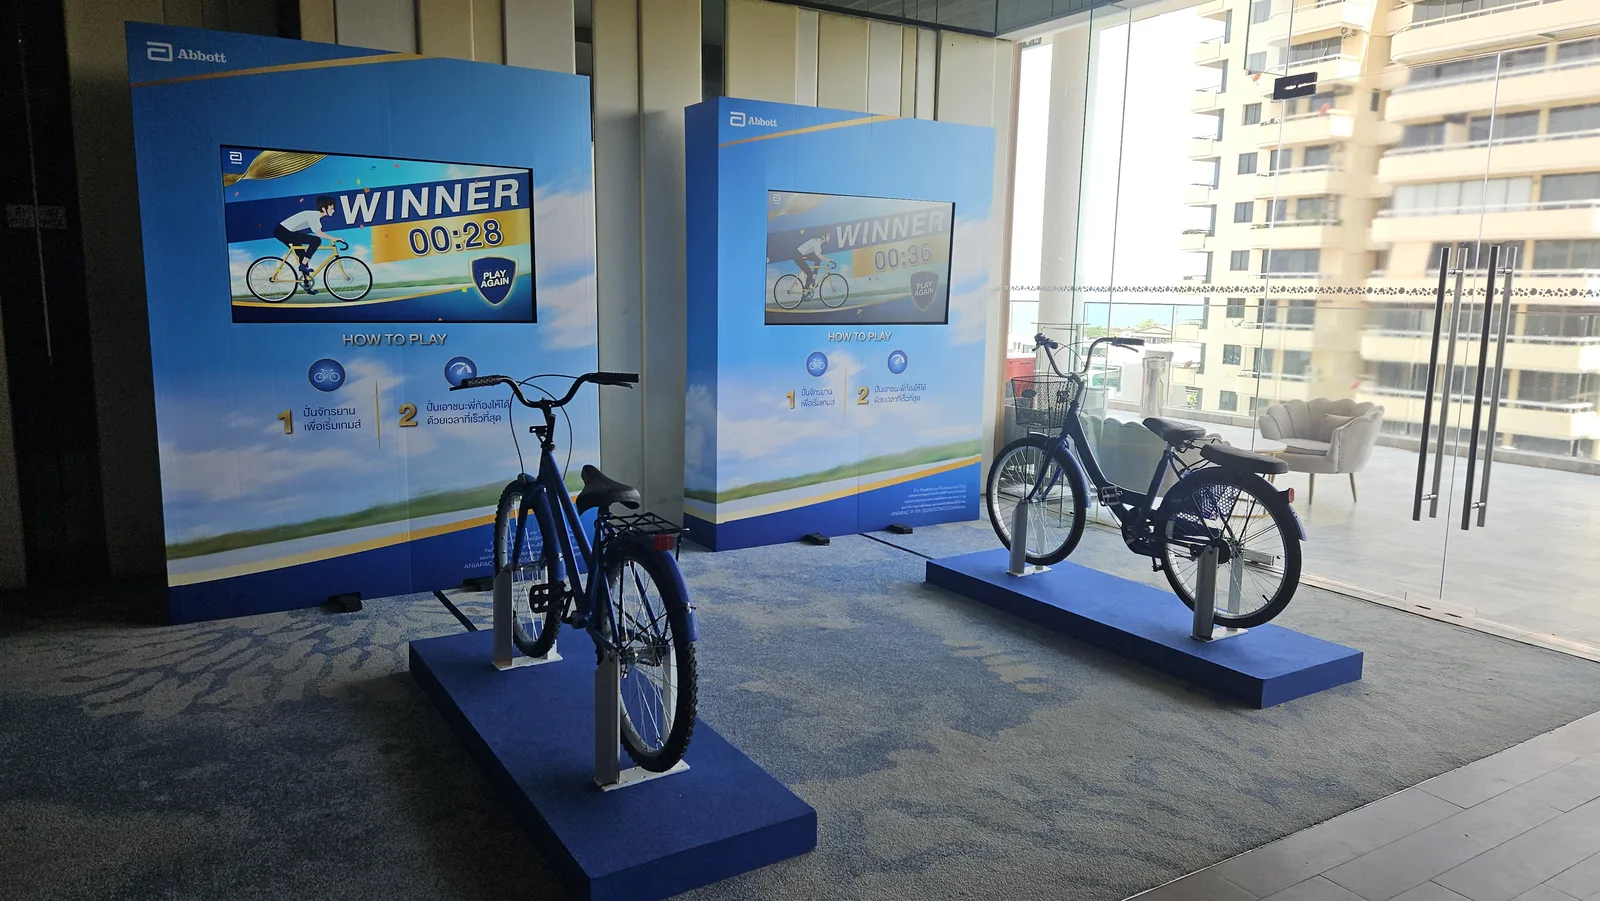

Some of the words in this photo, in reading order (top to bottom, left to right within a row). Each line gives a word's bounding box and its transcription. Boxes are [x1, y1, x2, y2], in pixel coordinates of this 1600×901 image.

[177, 47, 228, 65] Abbott
[747, 116, 778, 128] Abbott
[339, 178, 521, 226] WINNER
[408, 217, 504, 257] 00:28
[835, 211, 945, 248] WINNER
[873, 242, 934, 272] 00:36
[480, 276, 510, 289] AGAIN
[482, 269, 507, 281] PLAY
[914, 287, 935, 298] AGAIN
[916, 281, 933, 290] PLAY
[342, 334, 381, 347] HOW
[384, 333, 406, 346] TO
[409, 333, 448, 346] PLAY
[828, 332, 852, 343] HOW
[854, 332, 866, 342] TO
[868, 331, 892, 341] PLAY
[785, 389, 796, 409] 1
[857, 385, 870, 406] 2
[303, 404, 356, 418] ปั่นจักรยาน
[398, 403, 418, 428] 2
[427, 411, 502, 426] ด้วยเวลาที่เร็วที่สุด
[277, 408, 293, 435] 1
[304, 418, 362, 432] เพื่อเริ่มเกมส์
